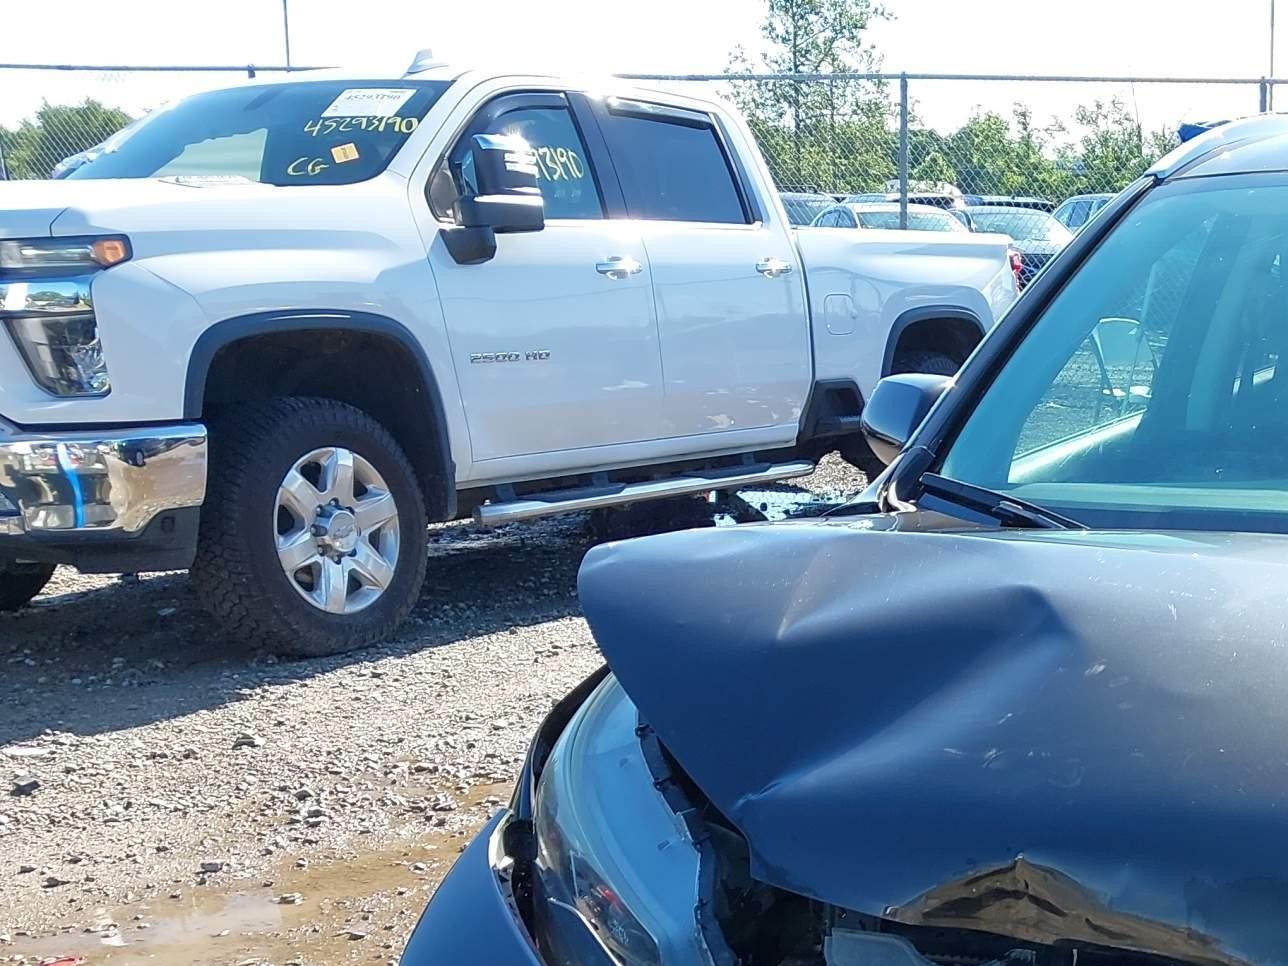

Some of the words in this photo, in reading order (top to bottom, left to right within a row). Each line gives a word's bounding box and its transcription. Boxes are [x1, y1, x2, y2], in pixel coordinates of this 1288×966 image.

[303, 115, 419, 137] 45293190
[470, 352, 521, 364] 2500
[525, 350, 551, 361] HD
